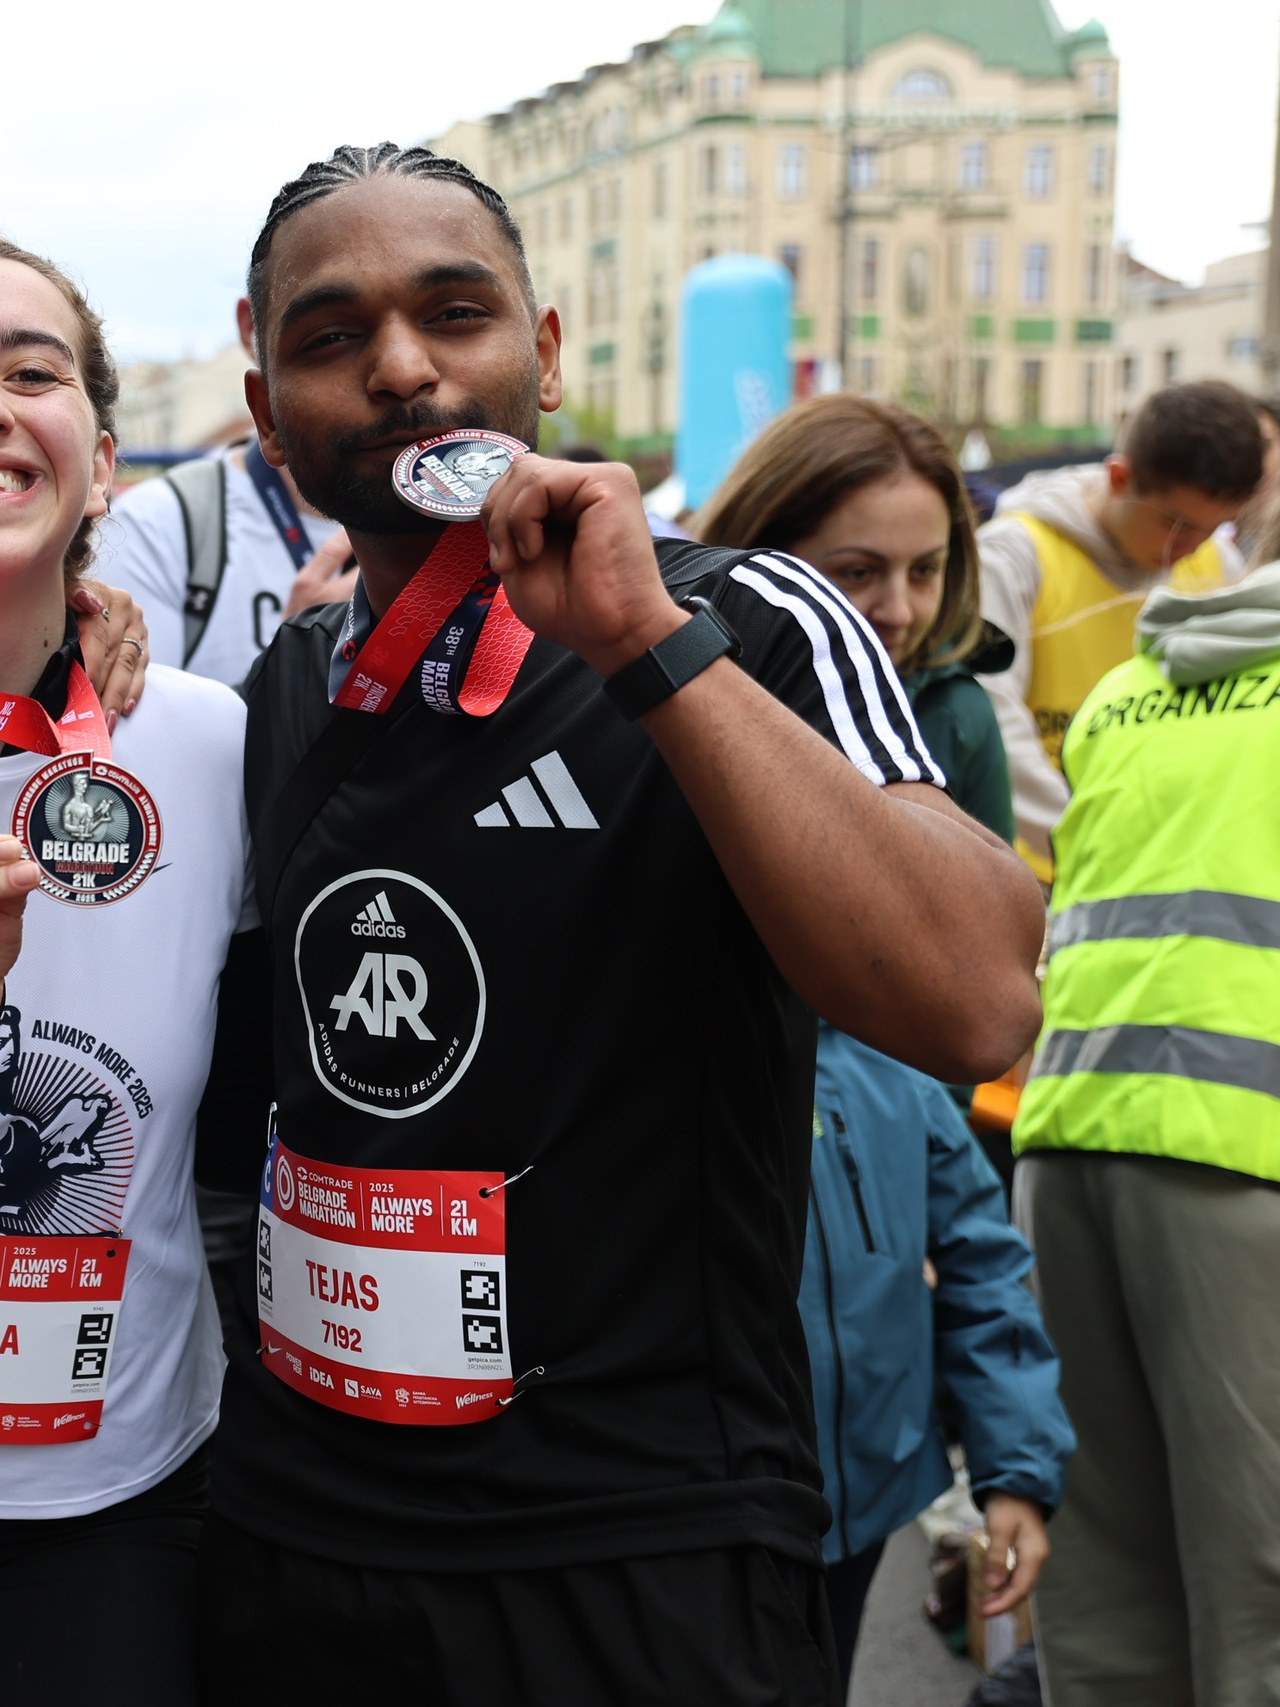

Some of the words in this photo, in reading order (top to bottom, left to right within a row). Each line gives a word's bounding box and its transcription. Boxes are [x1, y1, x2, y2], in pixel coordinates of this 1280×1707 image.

[420, 454, 477, 503] BELGRADE
[444, 626, 465, 656] 38TH
[41, 839, 130, 863] BELGRADE
[72, 873, 96, 888] 21K
[350, 919, 407, 939] adidas
[31, 1019, 97, 1055] ALWAYS
[94, 1042, 136, 1085] MORE
[126, 1078, 154, 1120] 2025
[318, 1022, 339, 1073] ADIDAS
[340, 1072, 401, 1098] RUNNERS
[411, 1036, 460, 1095] BELGRADE
[263, 1159, 271, 1194] C
[308, 1171, 354, 1190] COMTRADE
[297, 1181, 348, 1210] BELGRADE
[369, 1182, 395, 1193] 2025
[298, 1201, 357, 1229] MARATHON
[371, 1196, 433, 1217] ALWAYS
[450, 1200, 468, 1217] 21
[370, 1215, 415, 1234] MORE
[451, 1218, 477, 1236] KM
[13, 1247, 37, 1256] 2025
[10, 1258, 68, 1274] ALWAYS
[81, 1258, 97, 1273] 21
[473, 1260, 487, 1268] 7192
[8, 1272, 49, 1288] MORE
[79, 1272, 102, 1287] KM
[305, 1258, 380, 1312] TEJAS
[321, 1319, 363, 1353] 7192
[360, 1385, 382, 1397] SAVA
[455, 1391, 494, 1410] Wellness
[53, 1412, 86, 1429] Wellness
